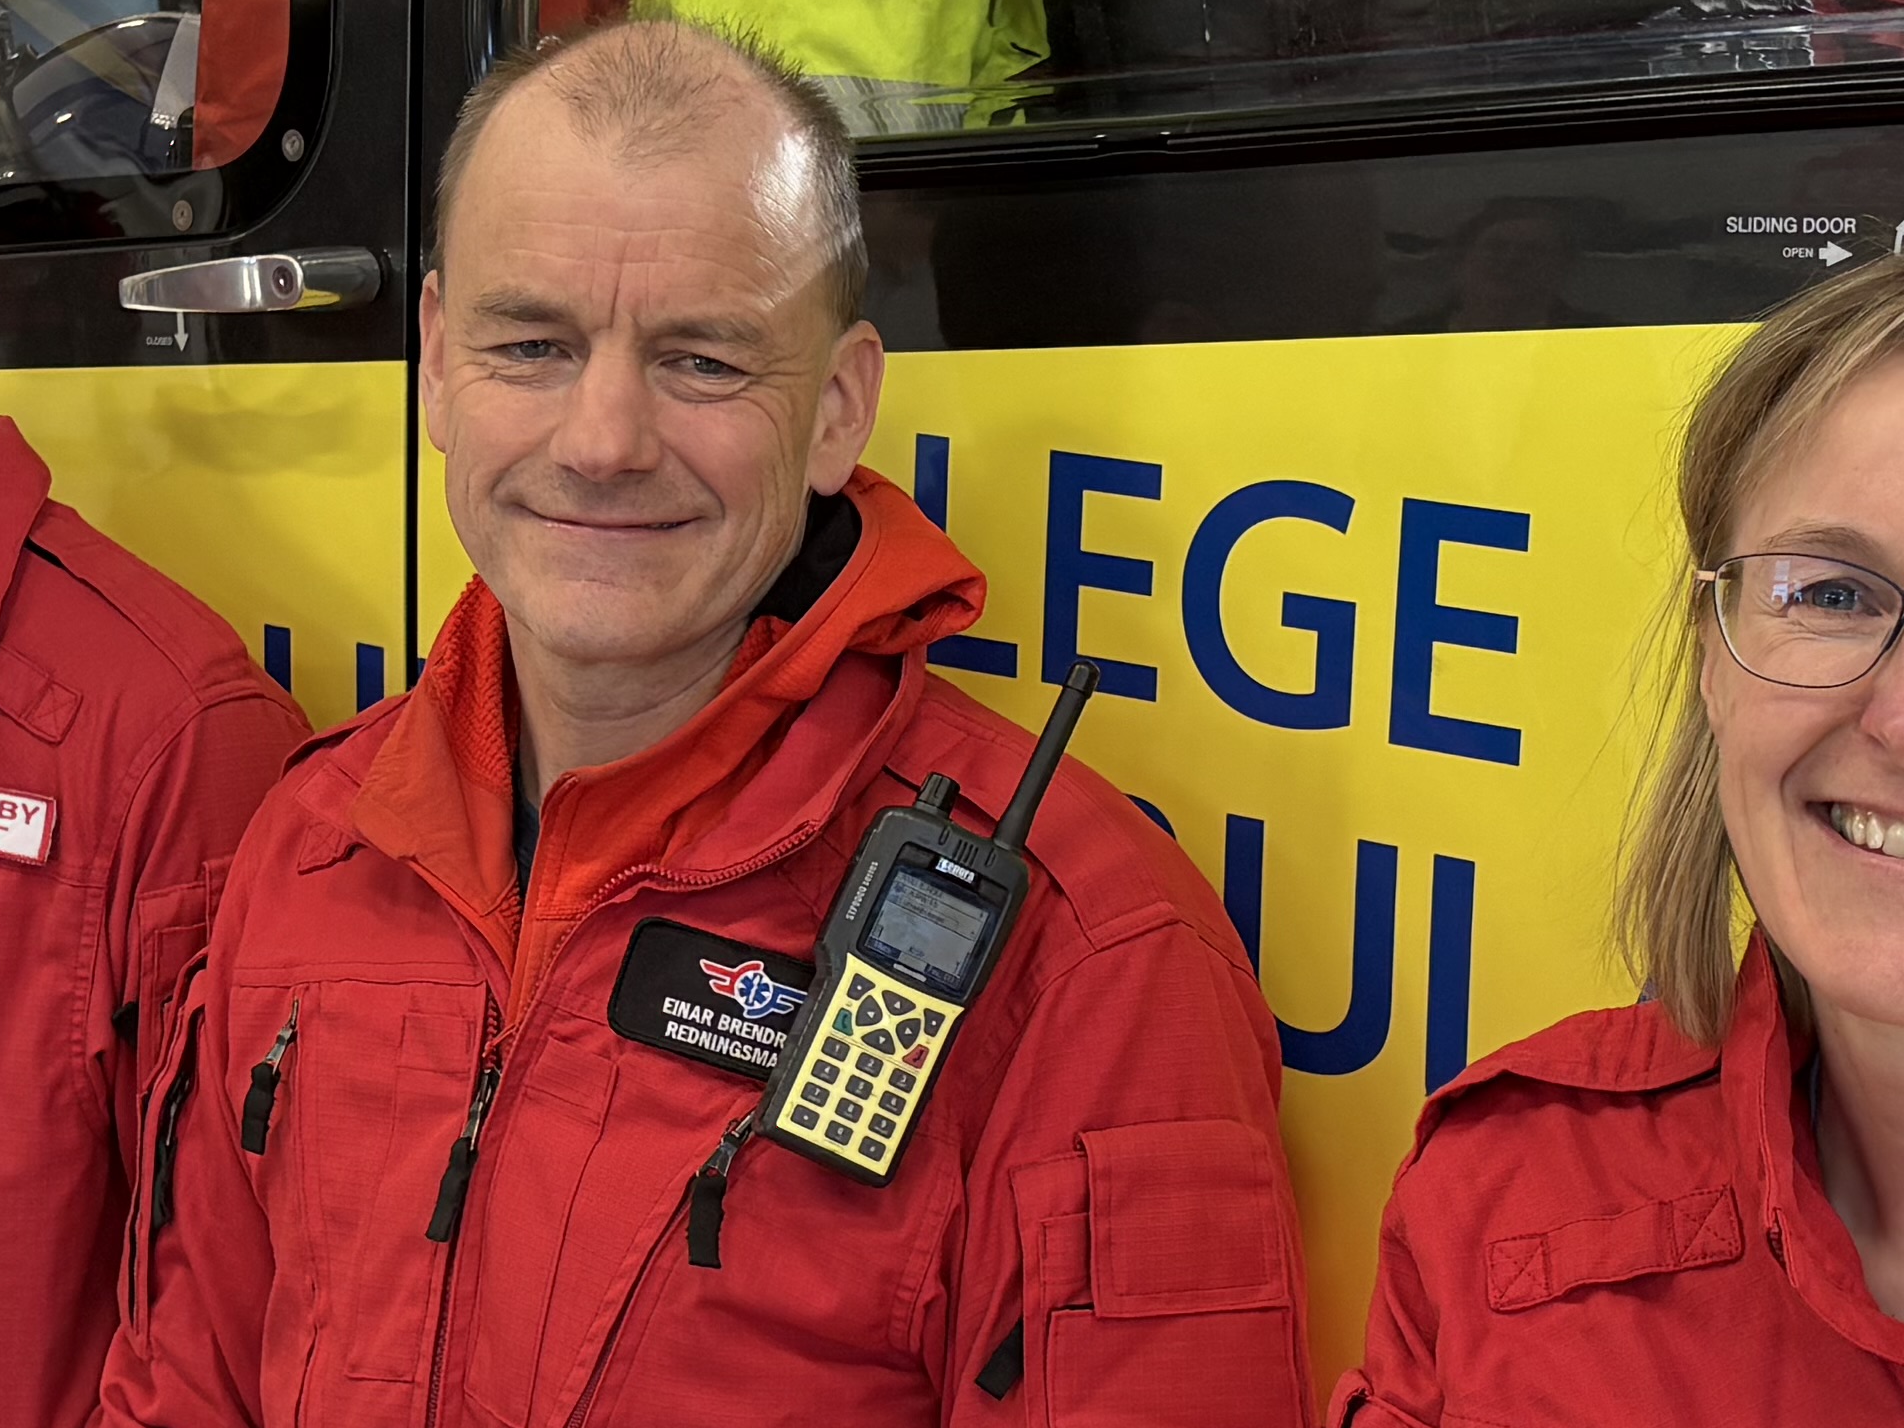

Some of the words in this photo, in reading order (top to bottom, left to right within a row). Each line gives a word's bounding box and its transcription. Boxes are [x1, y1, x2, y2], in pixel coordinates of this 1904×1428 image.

[1726, 216, 1797, 234] SLIDING
[1802, 217, 1857, 234] DOOR
[1782, 247, 1814, 259] OPEN
[913, 433, 1531, 767] LEGE
[662, 996, 715, 1027] EINAR
[717, 1013, 788, 1049] BRENDR
[664, 1020, 778, 1068] REDNINGSMA
